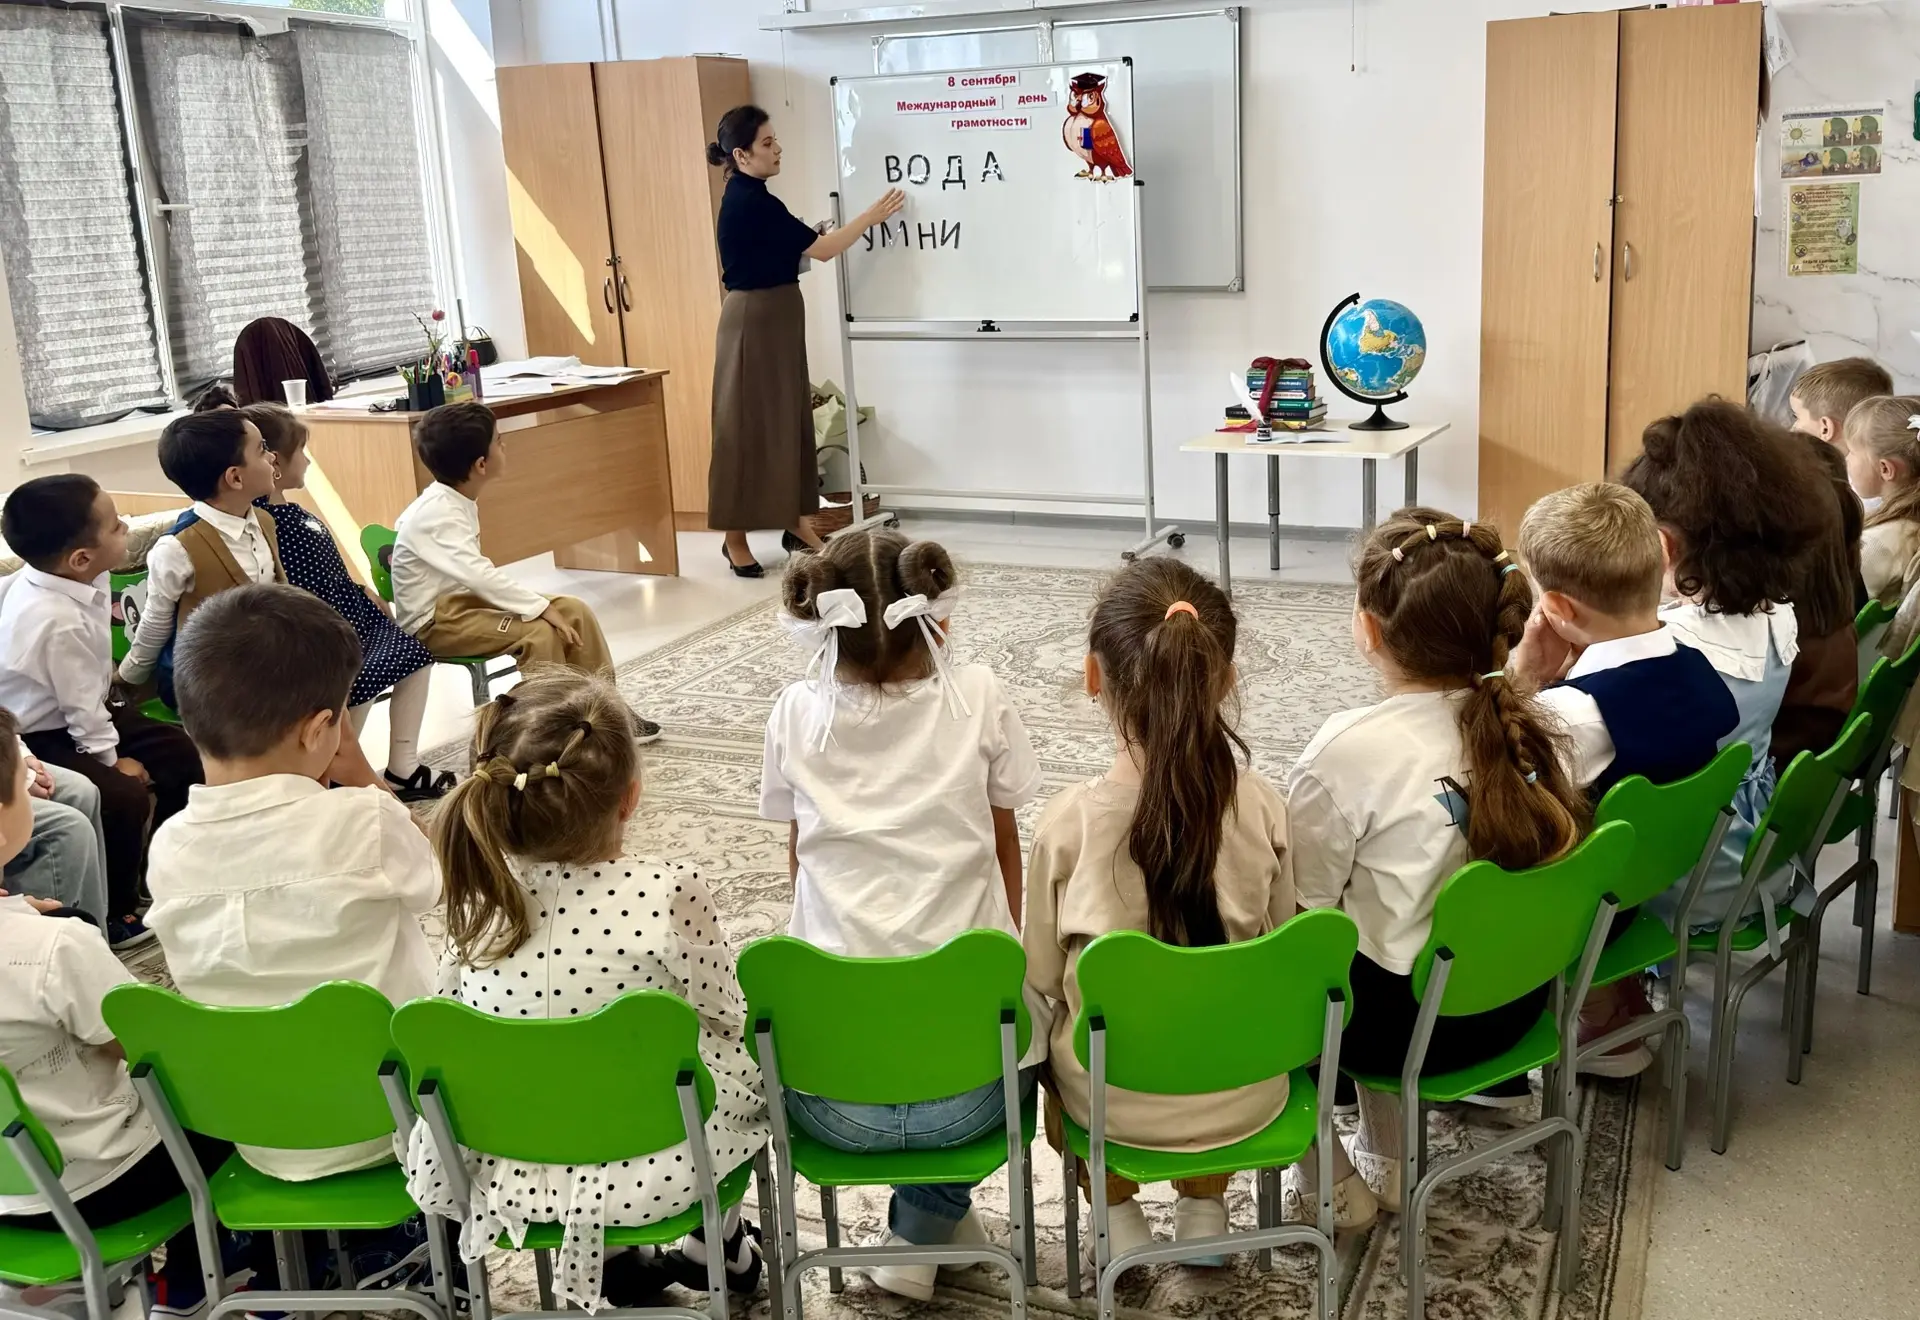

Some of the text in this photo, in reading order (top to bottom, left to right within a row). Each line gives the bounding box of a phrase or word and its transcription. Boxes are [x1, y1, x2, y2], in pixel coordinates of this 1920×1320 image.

[948, 74, 1016, 87] 8 сентября
[896, 93, 1047, 112] Международный день
[951, 117, 1027, 129] грамотности
[885, 151, 1004, 190] ВОДА
